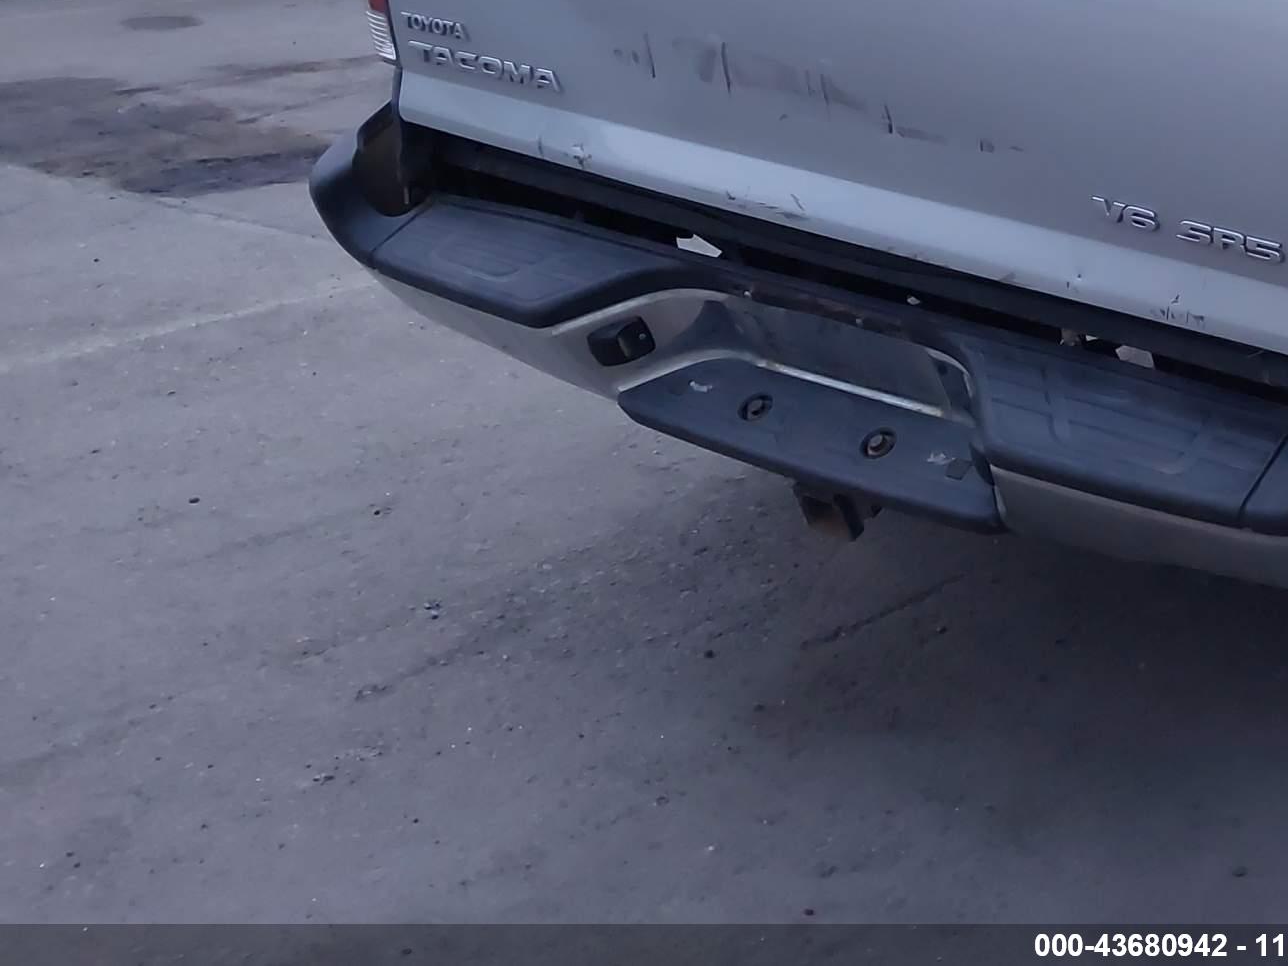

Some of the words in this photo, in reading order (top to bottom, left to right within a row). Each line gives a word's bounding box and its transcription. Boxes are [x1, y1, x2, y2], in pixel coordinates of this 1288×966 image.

[400, 11, 467, 39] TOYOTA
[408, 40, 562, 92] TACOMA
[1091, 196, 1159, 231] V6
[1176, 220, 1285, 262] SR5
